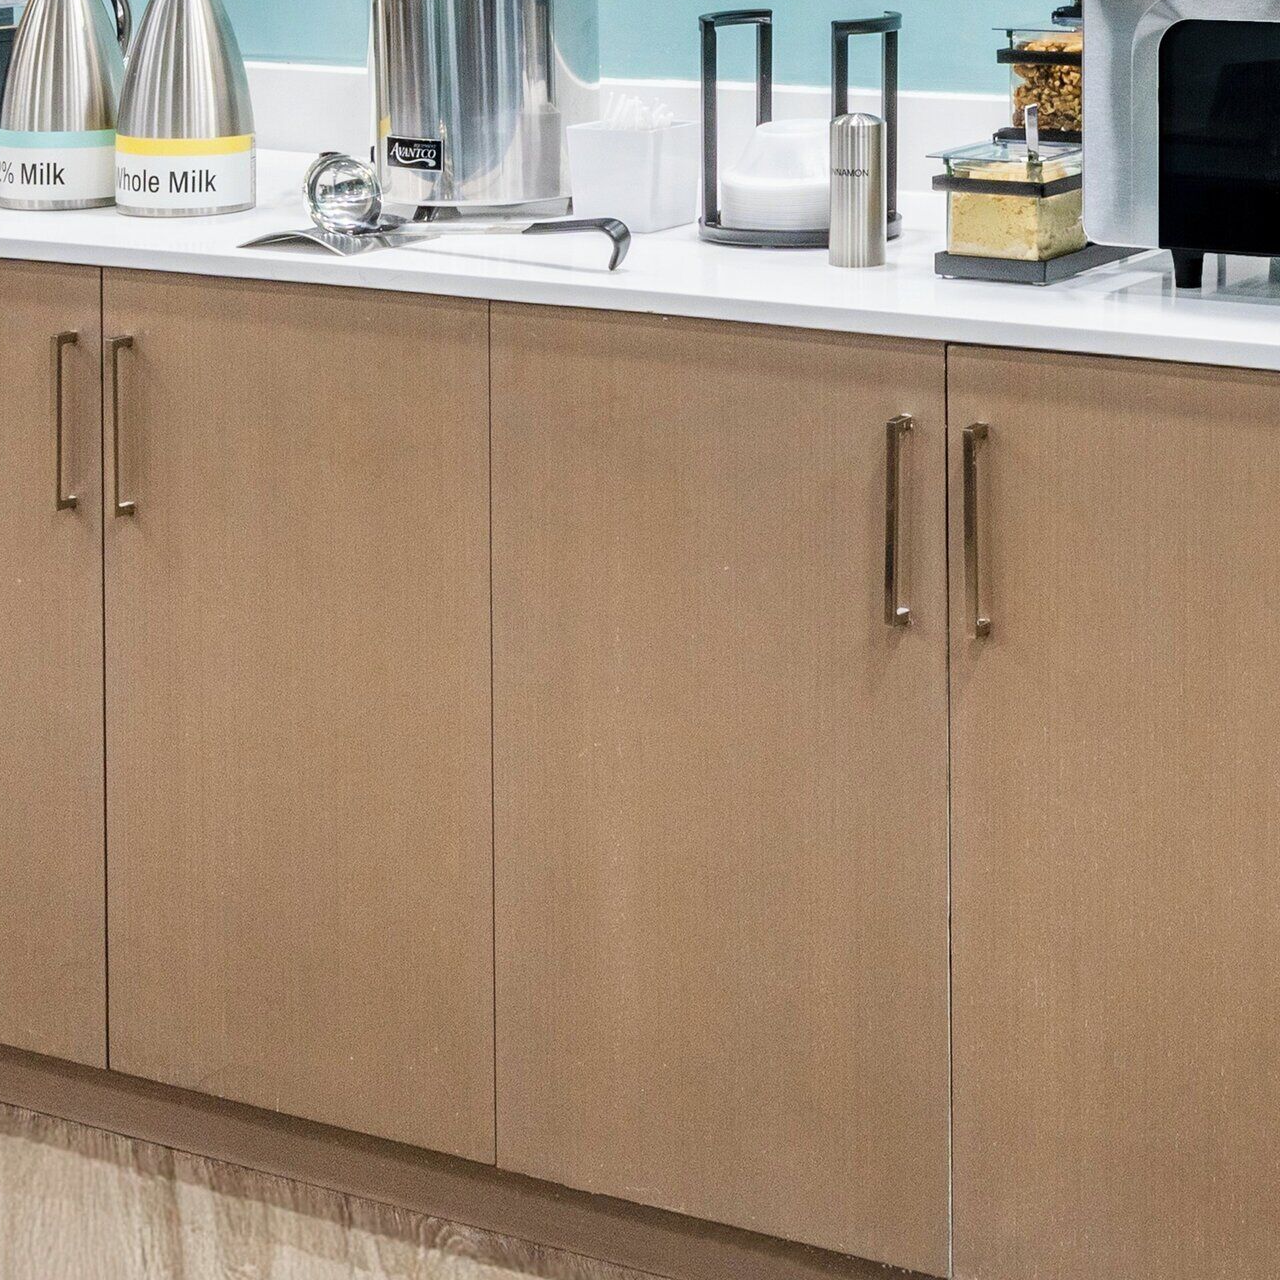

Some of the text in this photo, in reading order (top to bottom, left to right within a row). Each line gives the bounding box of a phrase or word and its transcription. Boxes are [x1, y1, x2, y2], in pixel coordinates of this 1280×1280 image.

[390, 142, 437, 163] AVANTCO
[20, 162, 66, 186] Milk
[169, 169, 217, 193] Milk
